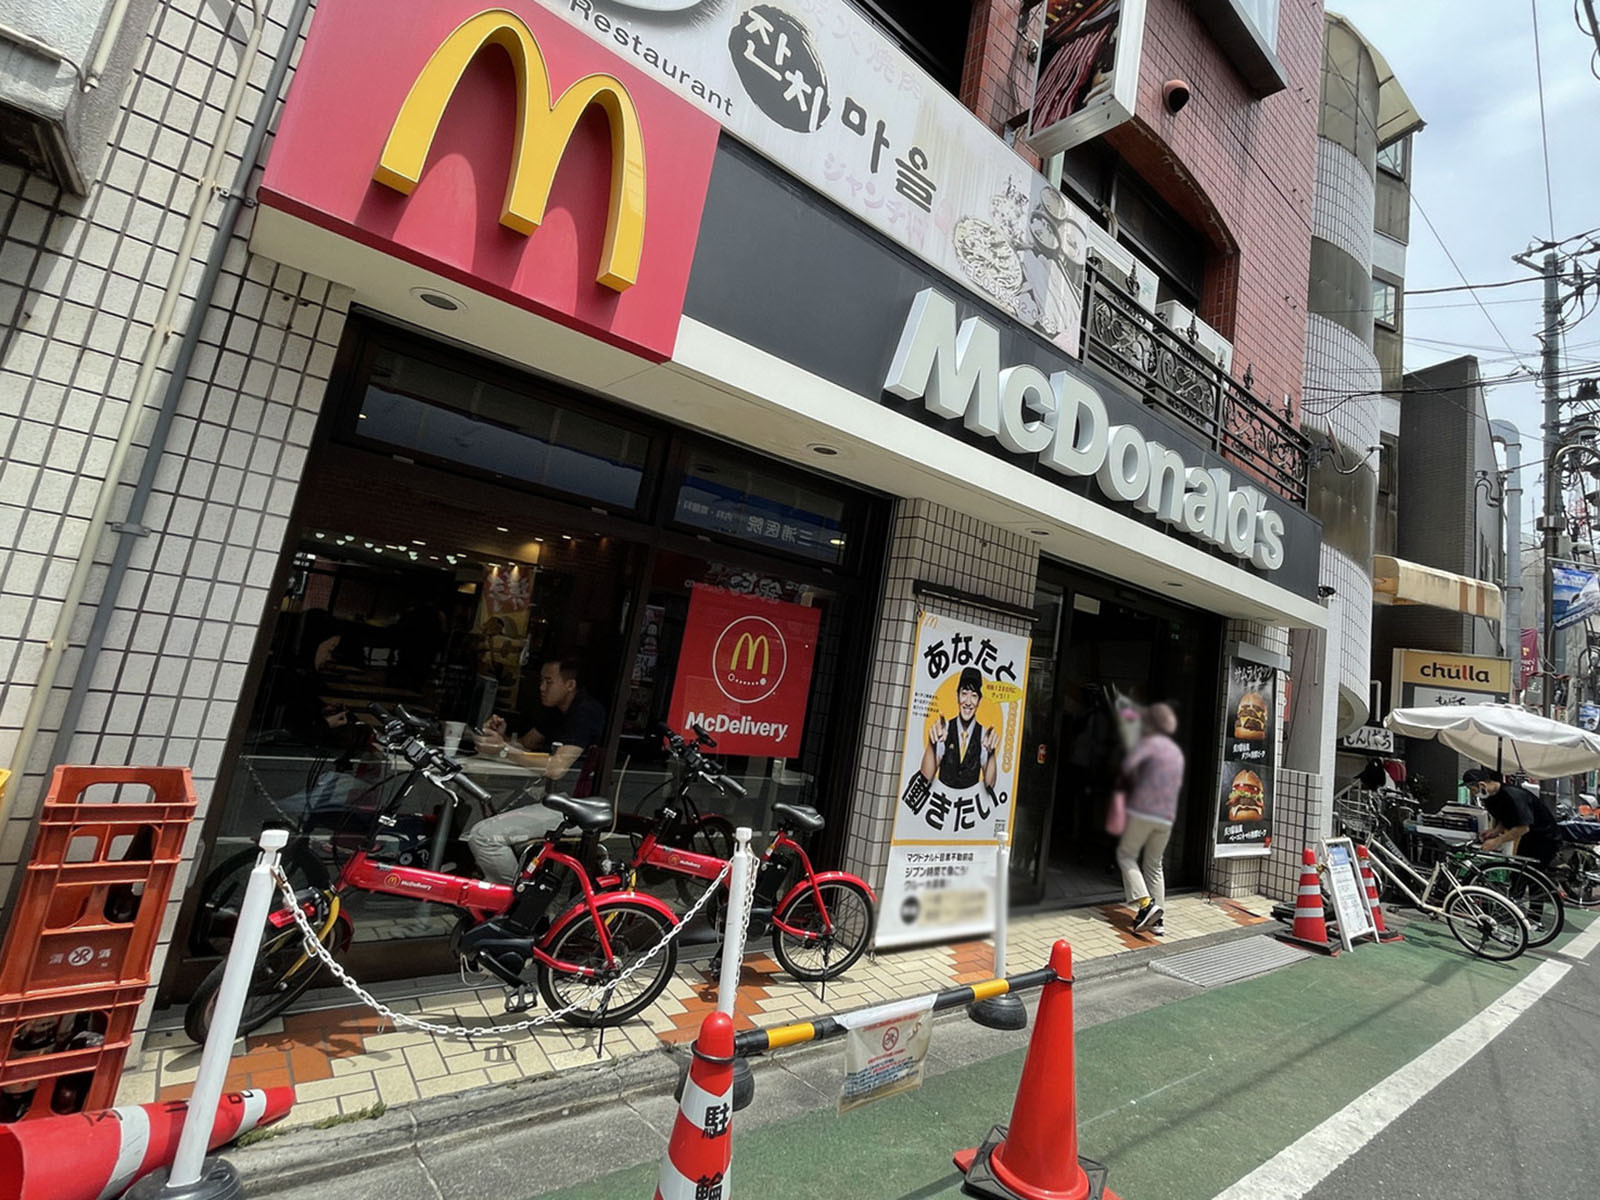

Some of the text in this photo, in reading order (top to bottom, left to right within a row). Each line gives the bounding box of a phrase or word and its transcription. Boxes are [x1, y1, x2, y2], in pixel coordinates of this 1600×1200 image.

[570, 0, 734, 117] Restaurant
[883, 287, 1285, 571] McDonald's
[924, 632, 1017, 681] あなたと
[1420, 662, 1490, 683] chulla
[684, 711, 788, 742] McDelivery
